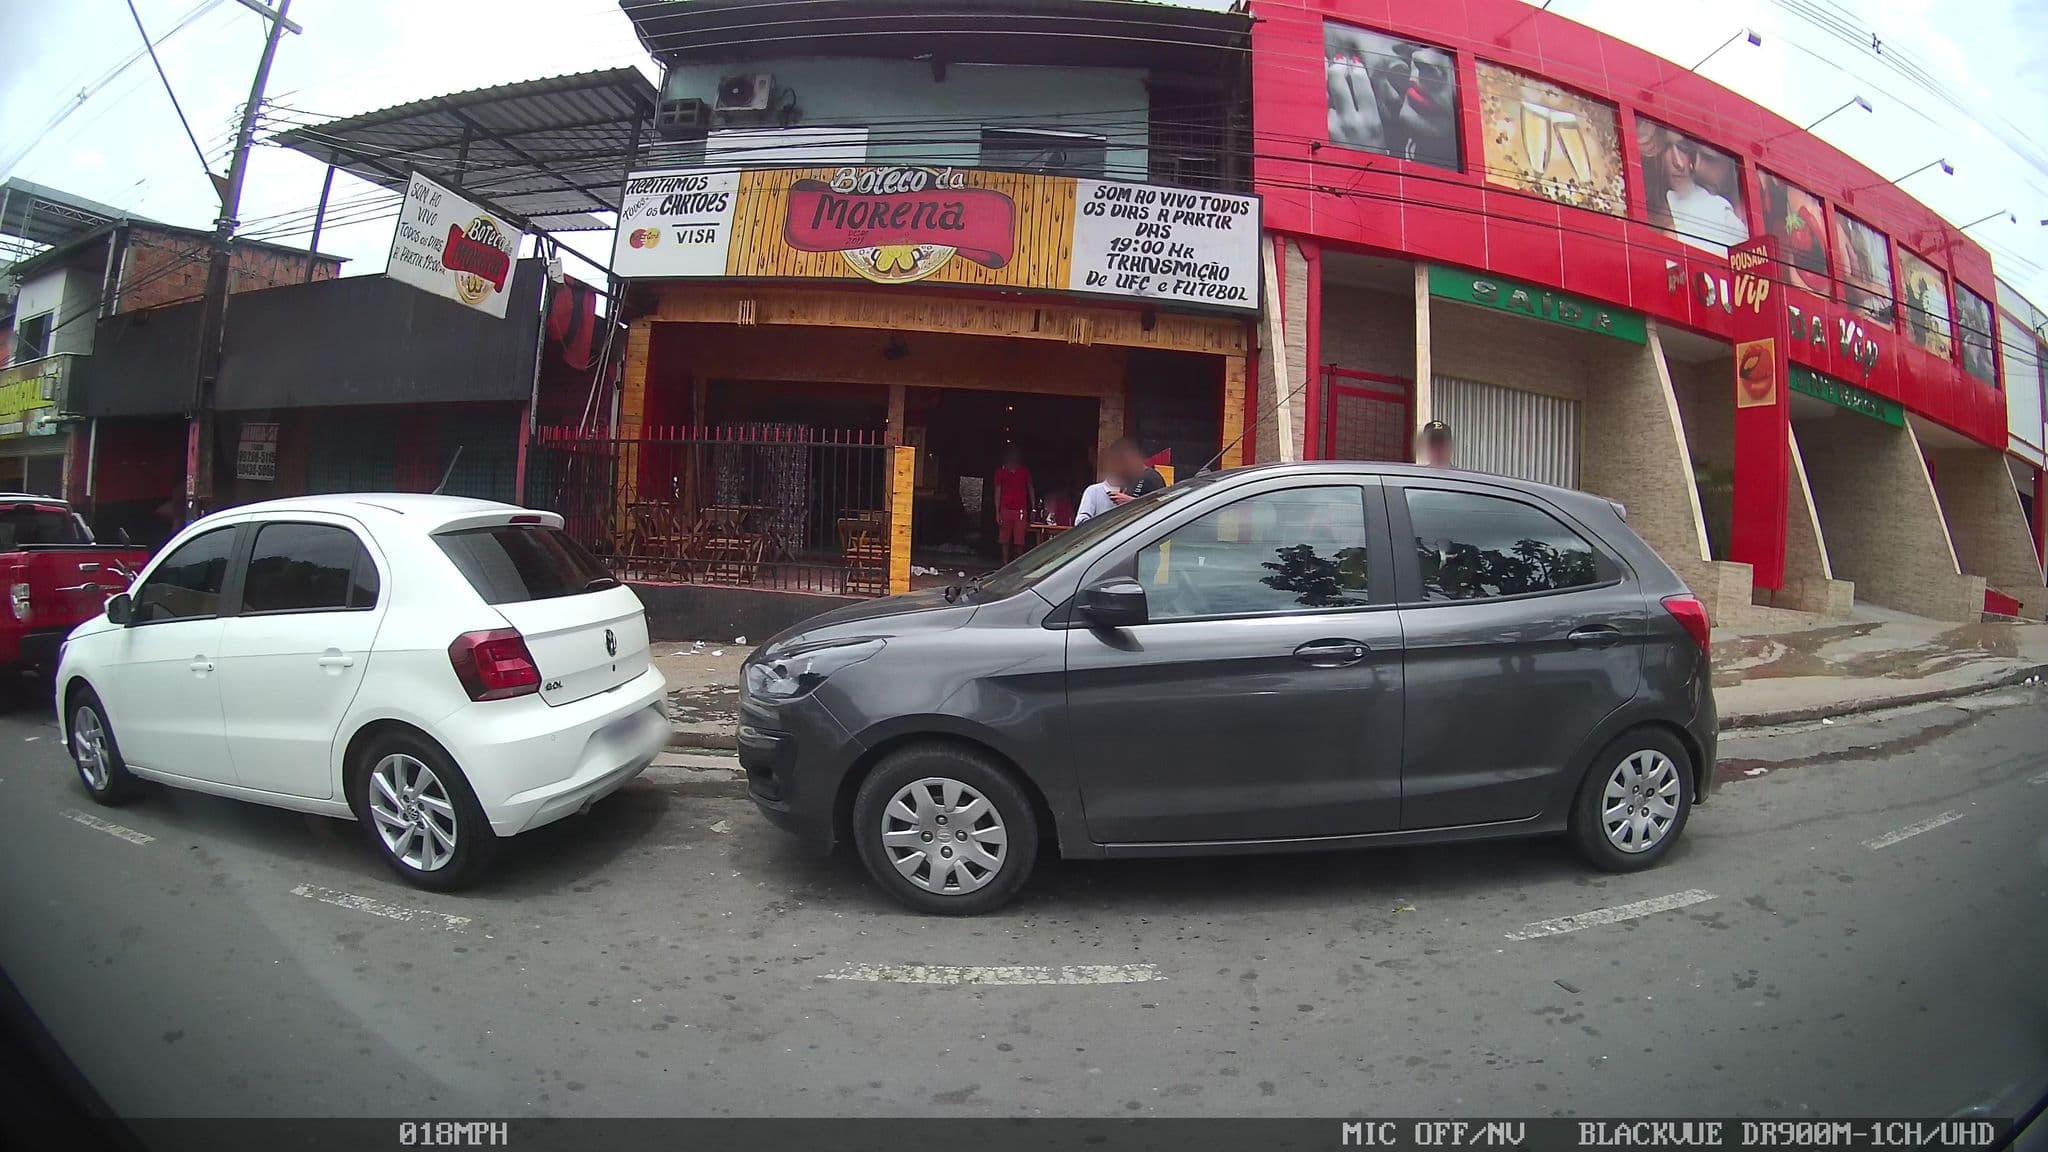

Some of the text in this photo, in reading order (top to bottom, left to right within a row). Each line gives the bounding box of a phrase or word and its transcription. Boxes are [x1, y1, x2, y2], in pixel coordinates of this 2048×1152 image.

[830, 167, 965, 195] Boteco da
[410, 182, 442, 207] SOM AO
[1094, 185, 1250, 216] SOM AO VIVO TODOS
[417, 207, 438, 226] VIVO
[646, 208, 658, 217] OS
[1083, 201, 1233, 230] OS DIAS A PARTIR
[400, 222, 421, 243] TODOS
[677, 229, 716, 243] VISA
[1135, 222, 1172, 239] DAS
[1110, 237, 1165, 255] 19:00
[1106, 252, 1230, 282] TRANSMIÇÃO
[1730, 245, 1769, 272] POUSADA
[1115, 274, 1150, 291] UFC
[1734, 272, 1770, 314] Vip
[545, 680, 564, 692] GOL
